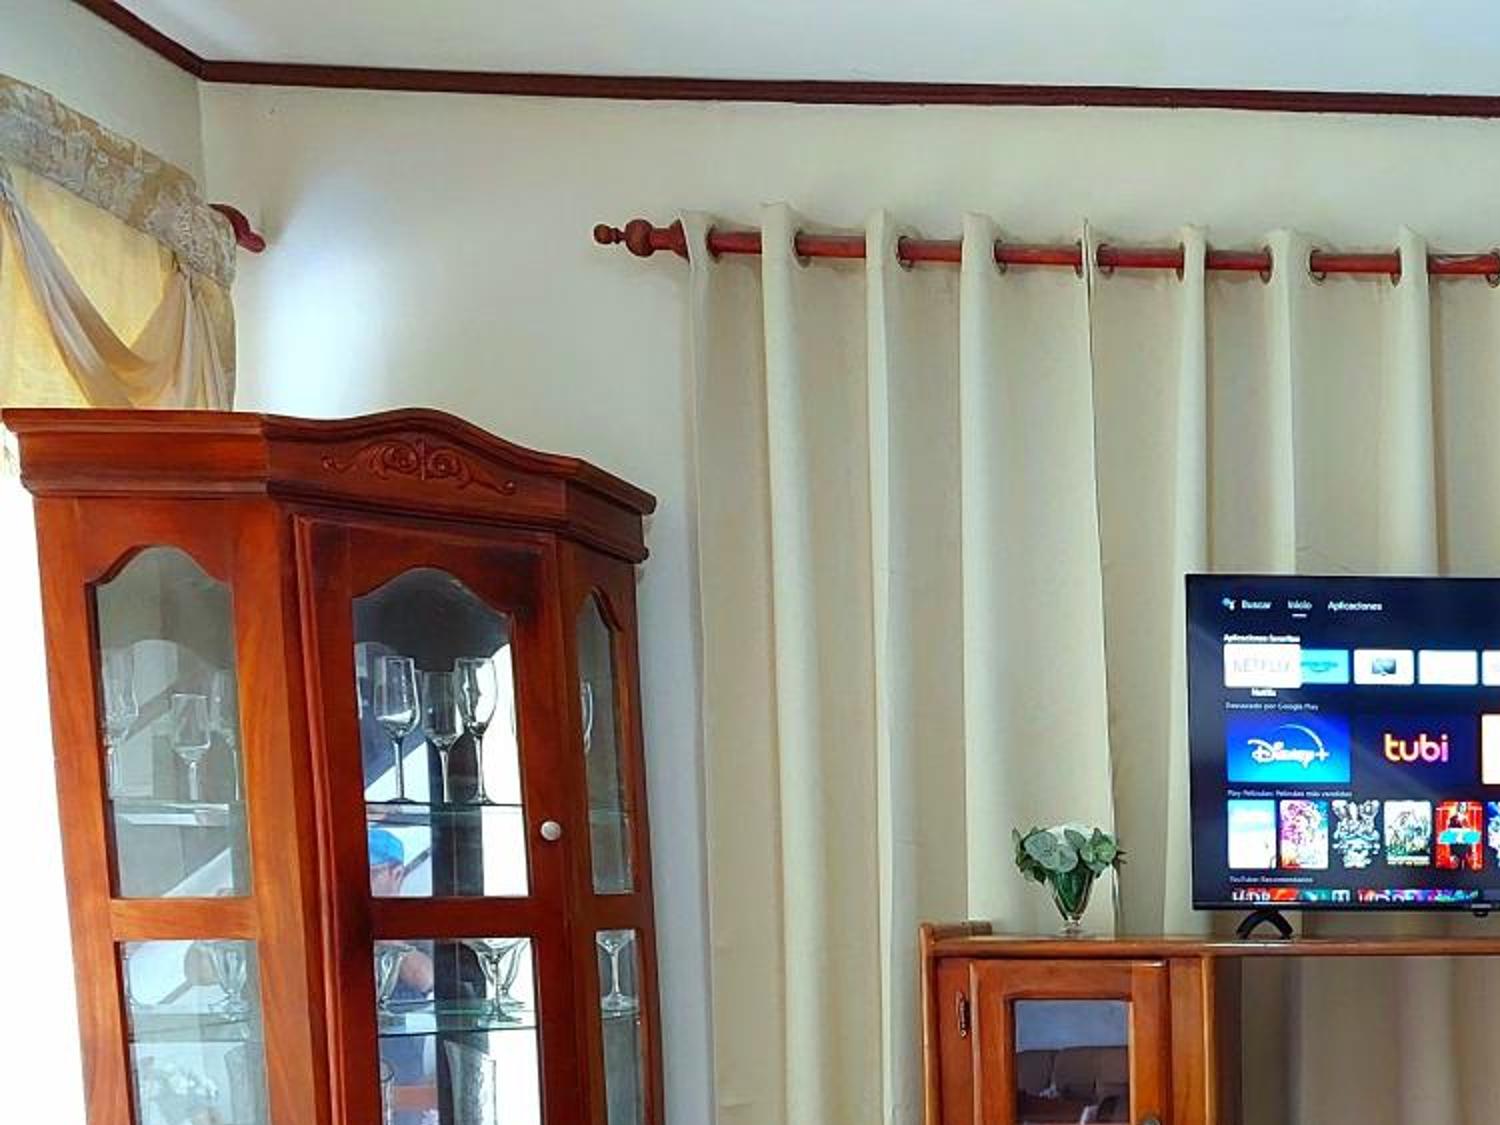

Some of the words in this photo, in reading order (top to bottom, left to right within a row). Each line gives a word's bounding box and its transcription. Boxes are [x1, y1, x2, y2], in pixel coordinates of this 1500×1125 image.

[1241, 600, 1272, 609] Buscar
[1328, 600, 1383, 612] Aplicaciones
[1384, 733, 1449, 763] tubi
